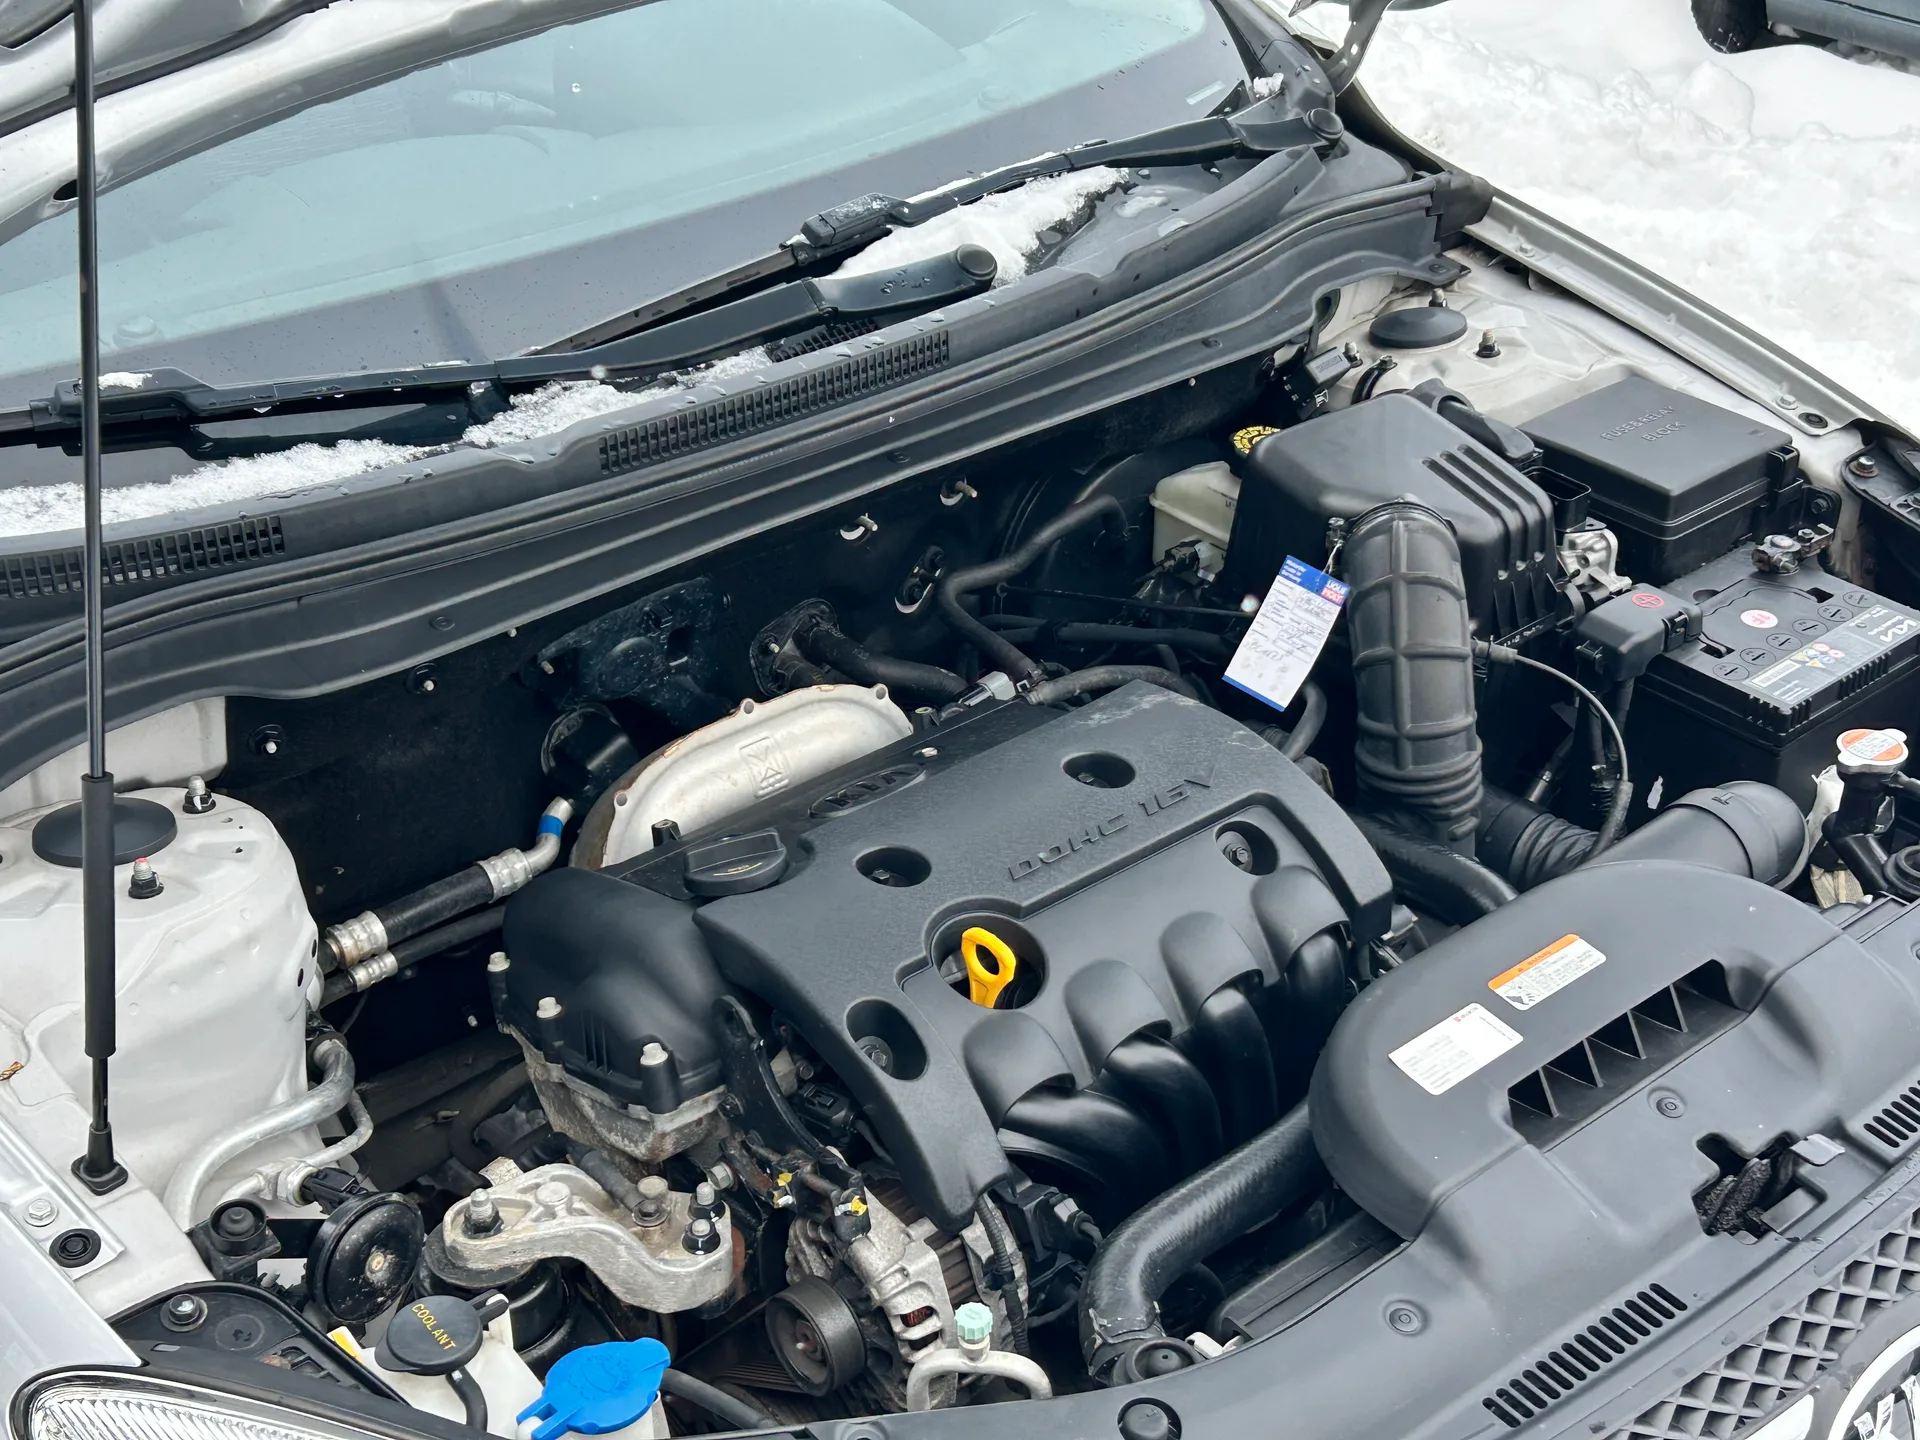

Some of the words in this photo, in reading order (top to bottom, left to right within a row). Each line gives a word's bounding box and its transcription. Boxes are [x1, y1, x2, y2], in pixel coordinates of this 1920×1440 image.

[1641, 421, 1686, 442] BLOCK
[1321, 587, 1343, 604] MOLY
[1880, 619, 1918, 643] KIA
[1007, 814, 1128, 881] DOHC
[1138, 765, 1216, 816] 16V
[412, 1304, 456, 1349] COOLANT
